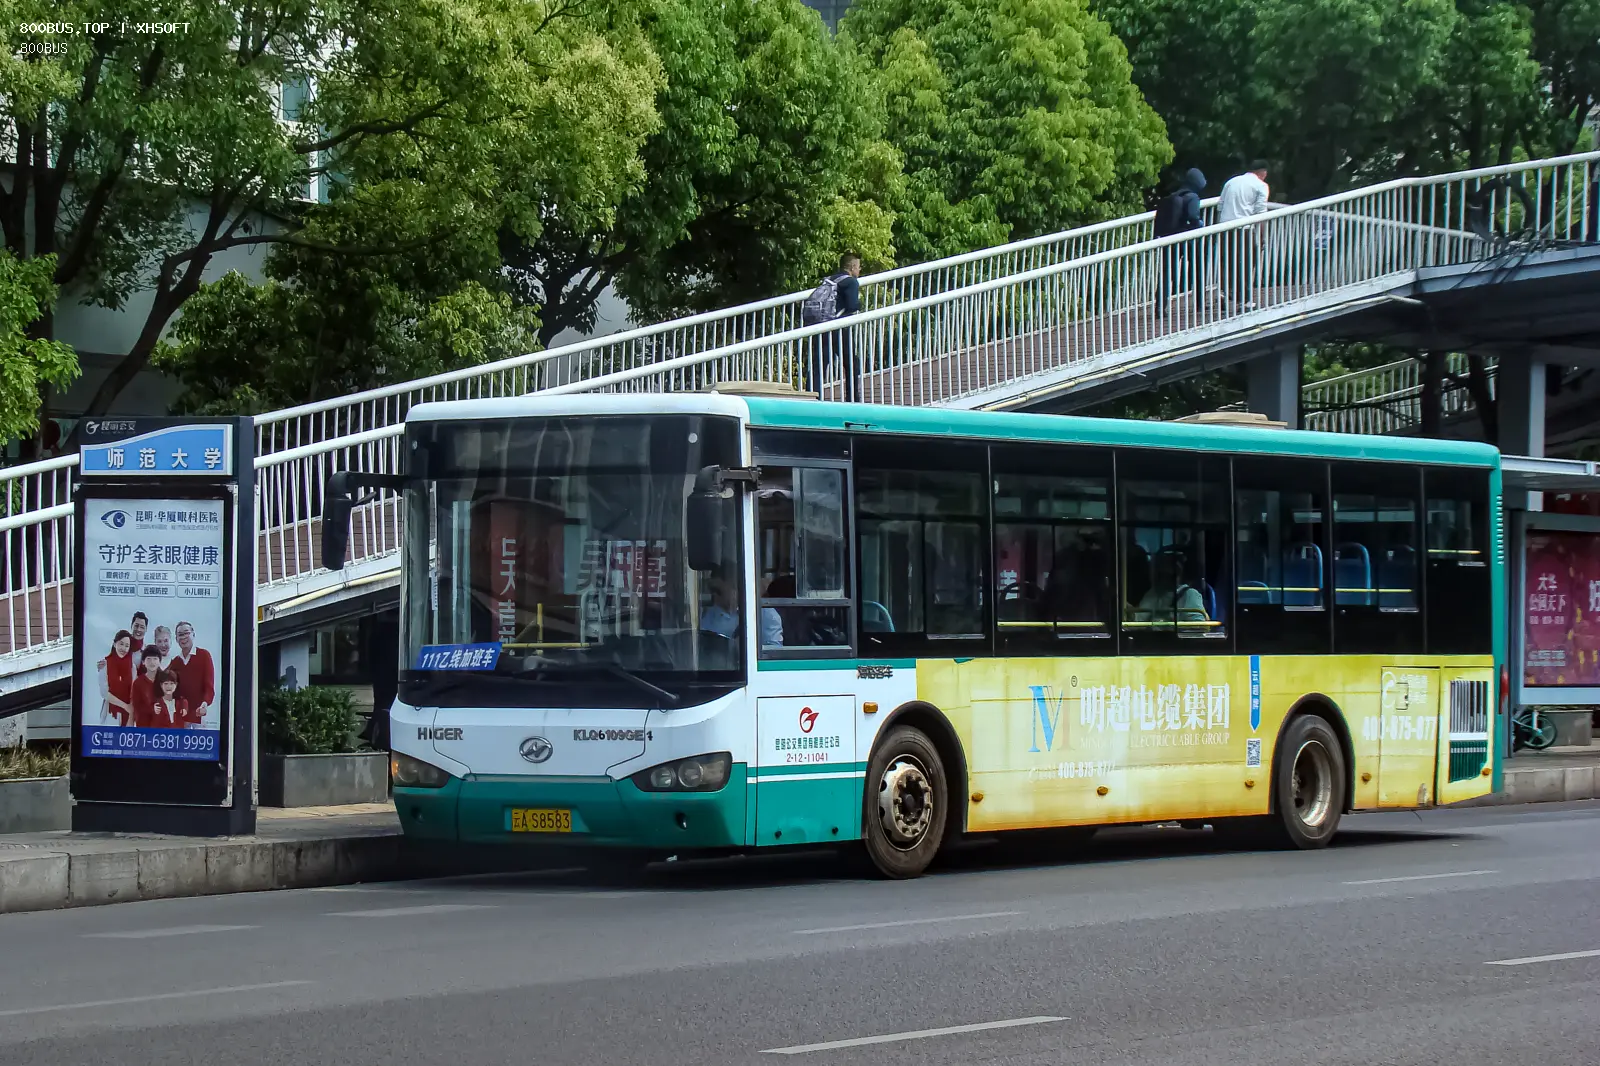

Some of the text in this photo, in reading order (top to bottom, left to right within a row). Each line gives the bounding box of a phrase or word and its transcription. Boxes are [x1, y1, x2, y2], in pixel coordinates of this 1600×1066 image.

[107, 447, 222, 469] 师范大学
[98, 544, 219, 566] 守护全家眼健康
[184, 587, 212, 597] 小儿眼科
[421, 648, 496, 669] 111乙线加班车
[1079, 684, 1231, 733] 明超电缆集团
[118, 732, 180, 749] 0871-6381
[183, 735, 214, 751] 9999
[417, 726, 464, 740] HIGER
[1201, 732, 1231, 745] GROUP
